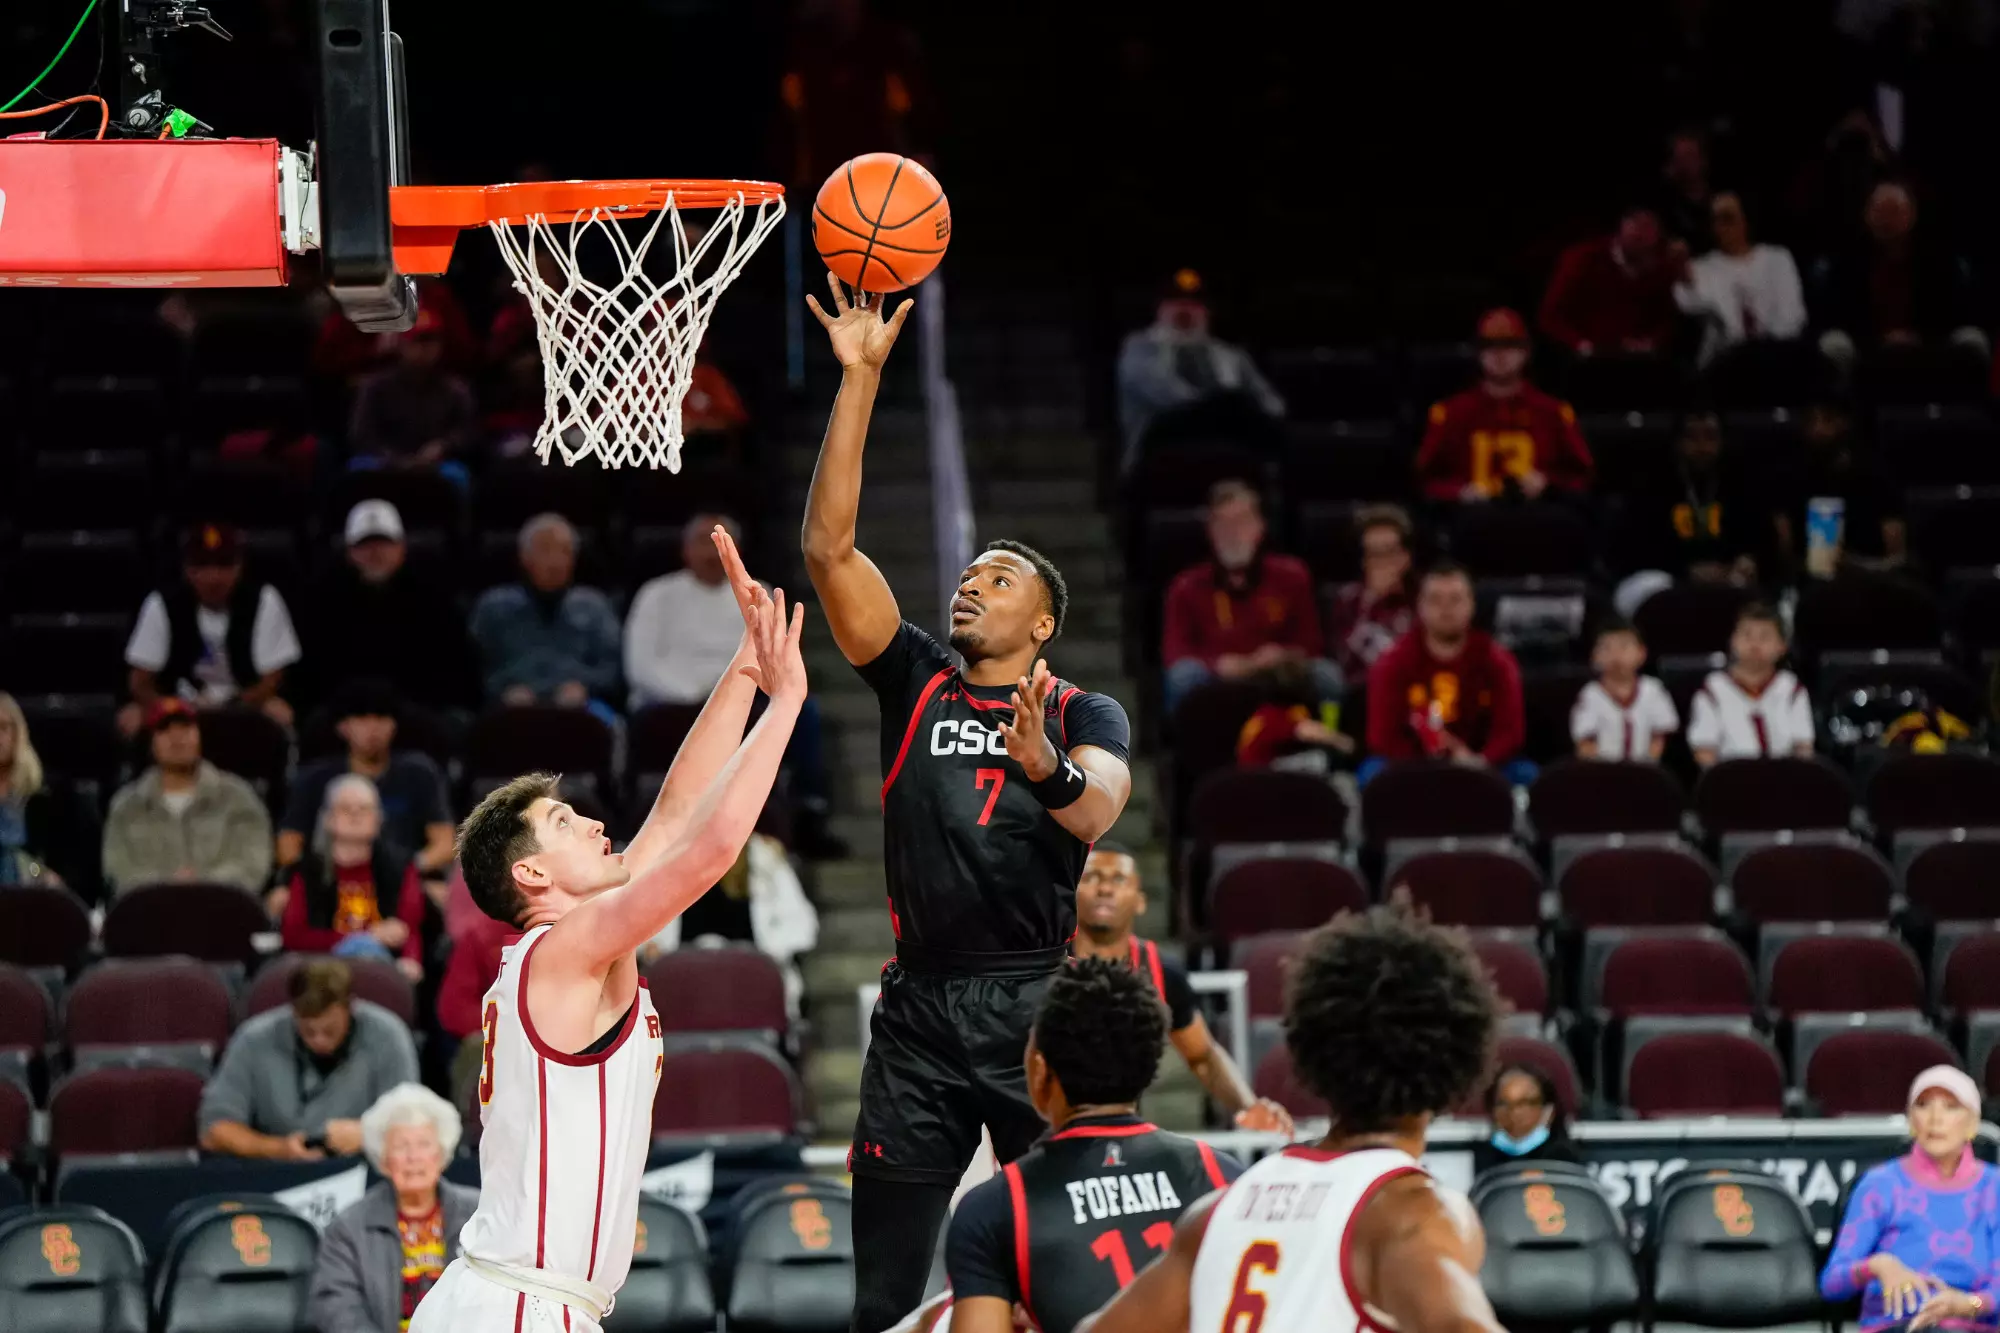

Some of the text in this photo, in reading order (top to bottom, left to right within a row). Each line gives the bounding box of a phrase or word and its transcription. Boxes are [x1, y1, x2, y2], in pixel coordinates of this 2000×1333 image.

[975, 767, 1005, 826] 7
[1065, 1171, 1182, 1225] FOFANA
[1220, 1238, 1281, 1333] 6
